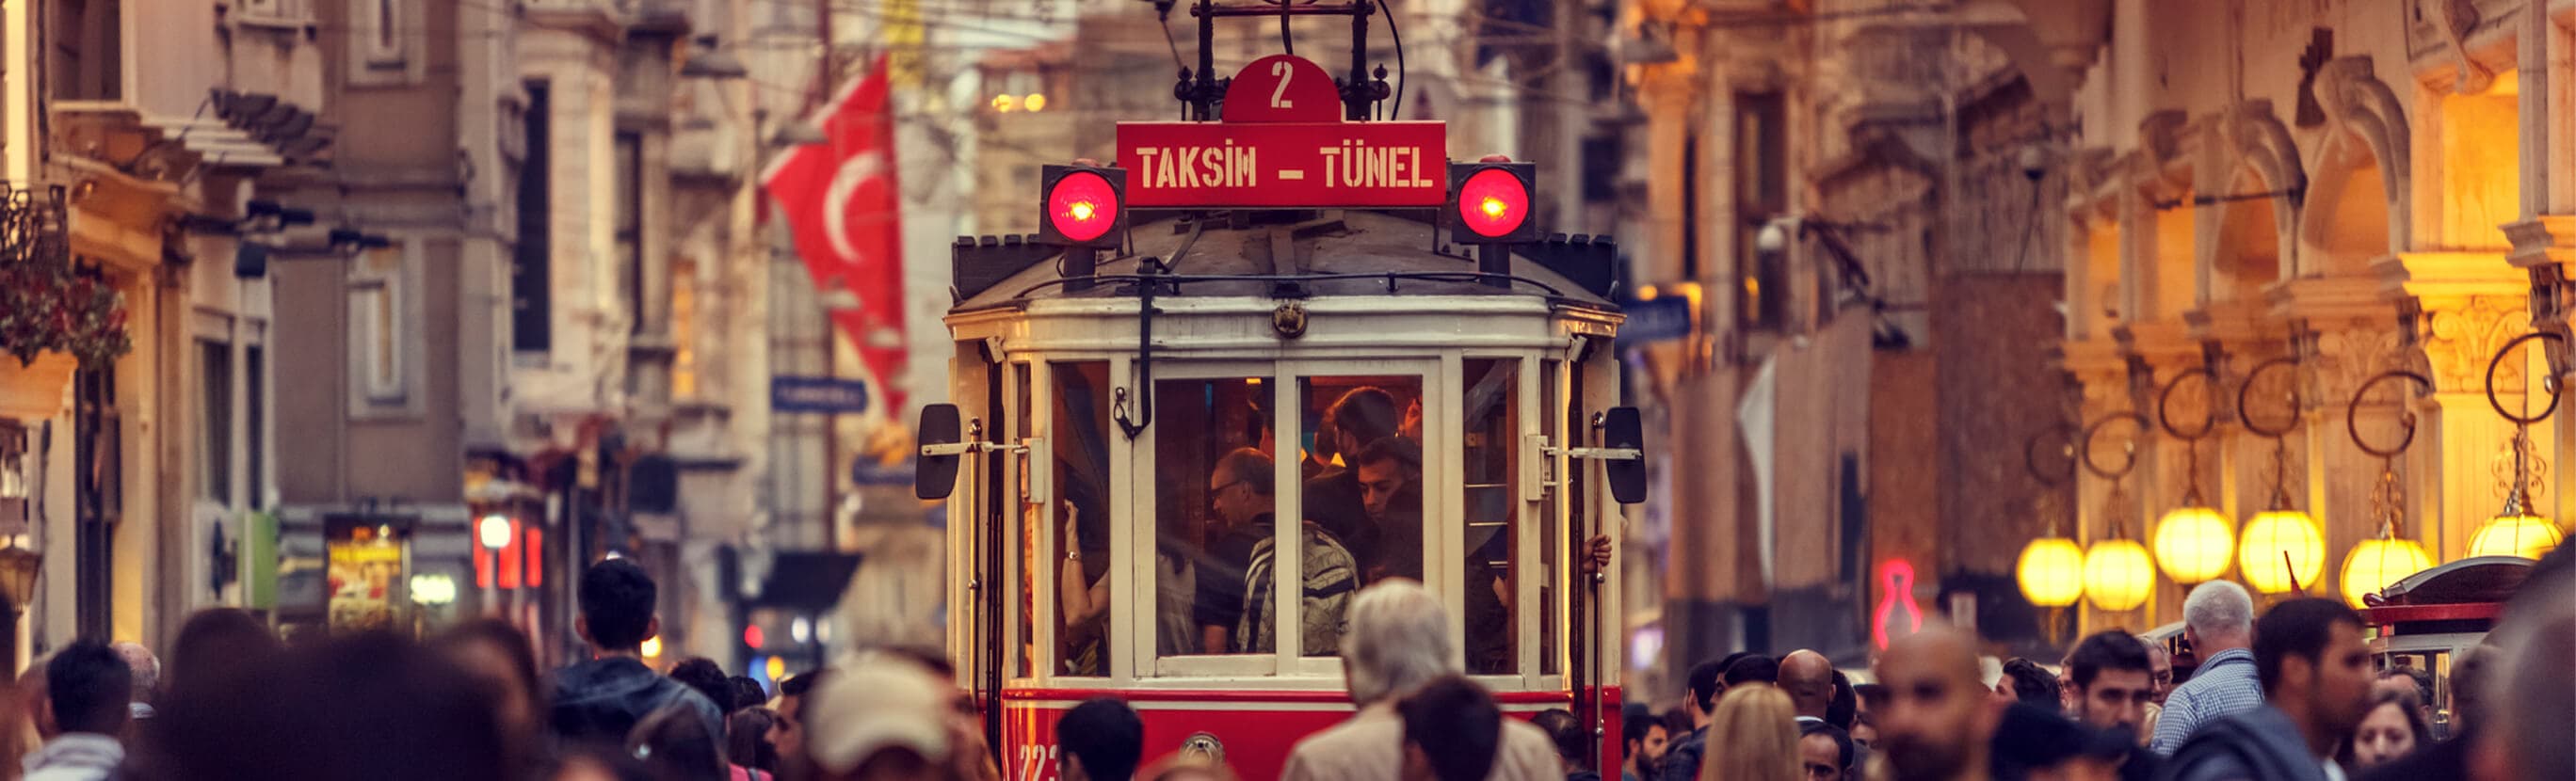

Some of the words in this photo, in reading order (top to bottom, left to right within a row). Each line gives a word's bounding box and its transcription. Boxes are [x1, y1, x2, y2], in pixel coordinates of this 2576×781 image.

[1271, 61, 1293, 108] 2
[1136, 138, 1256, 187] TAKSİM
[1320, 138, 1433, 187] TÜNEL
